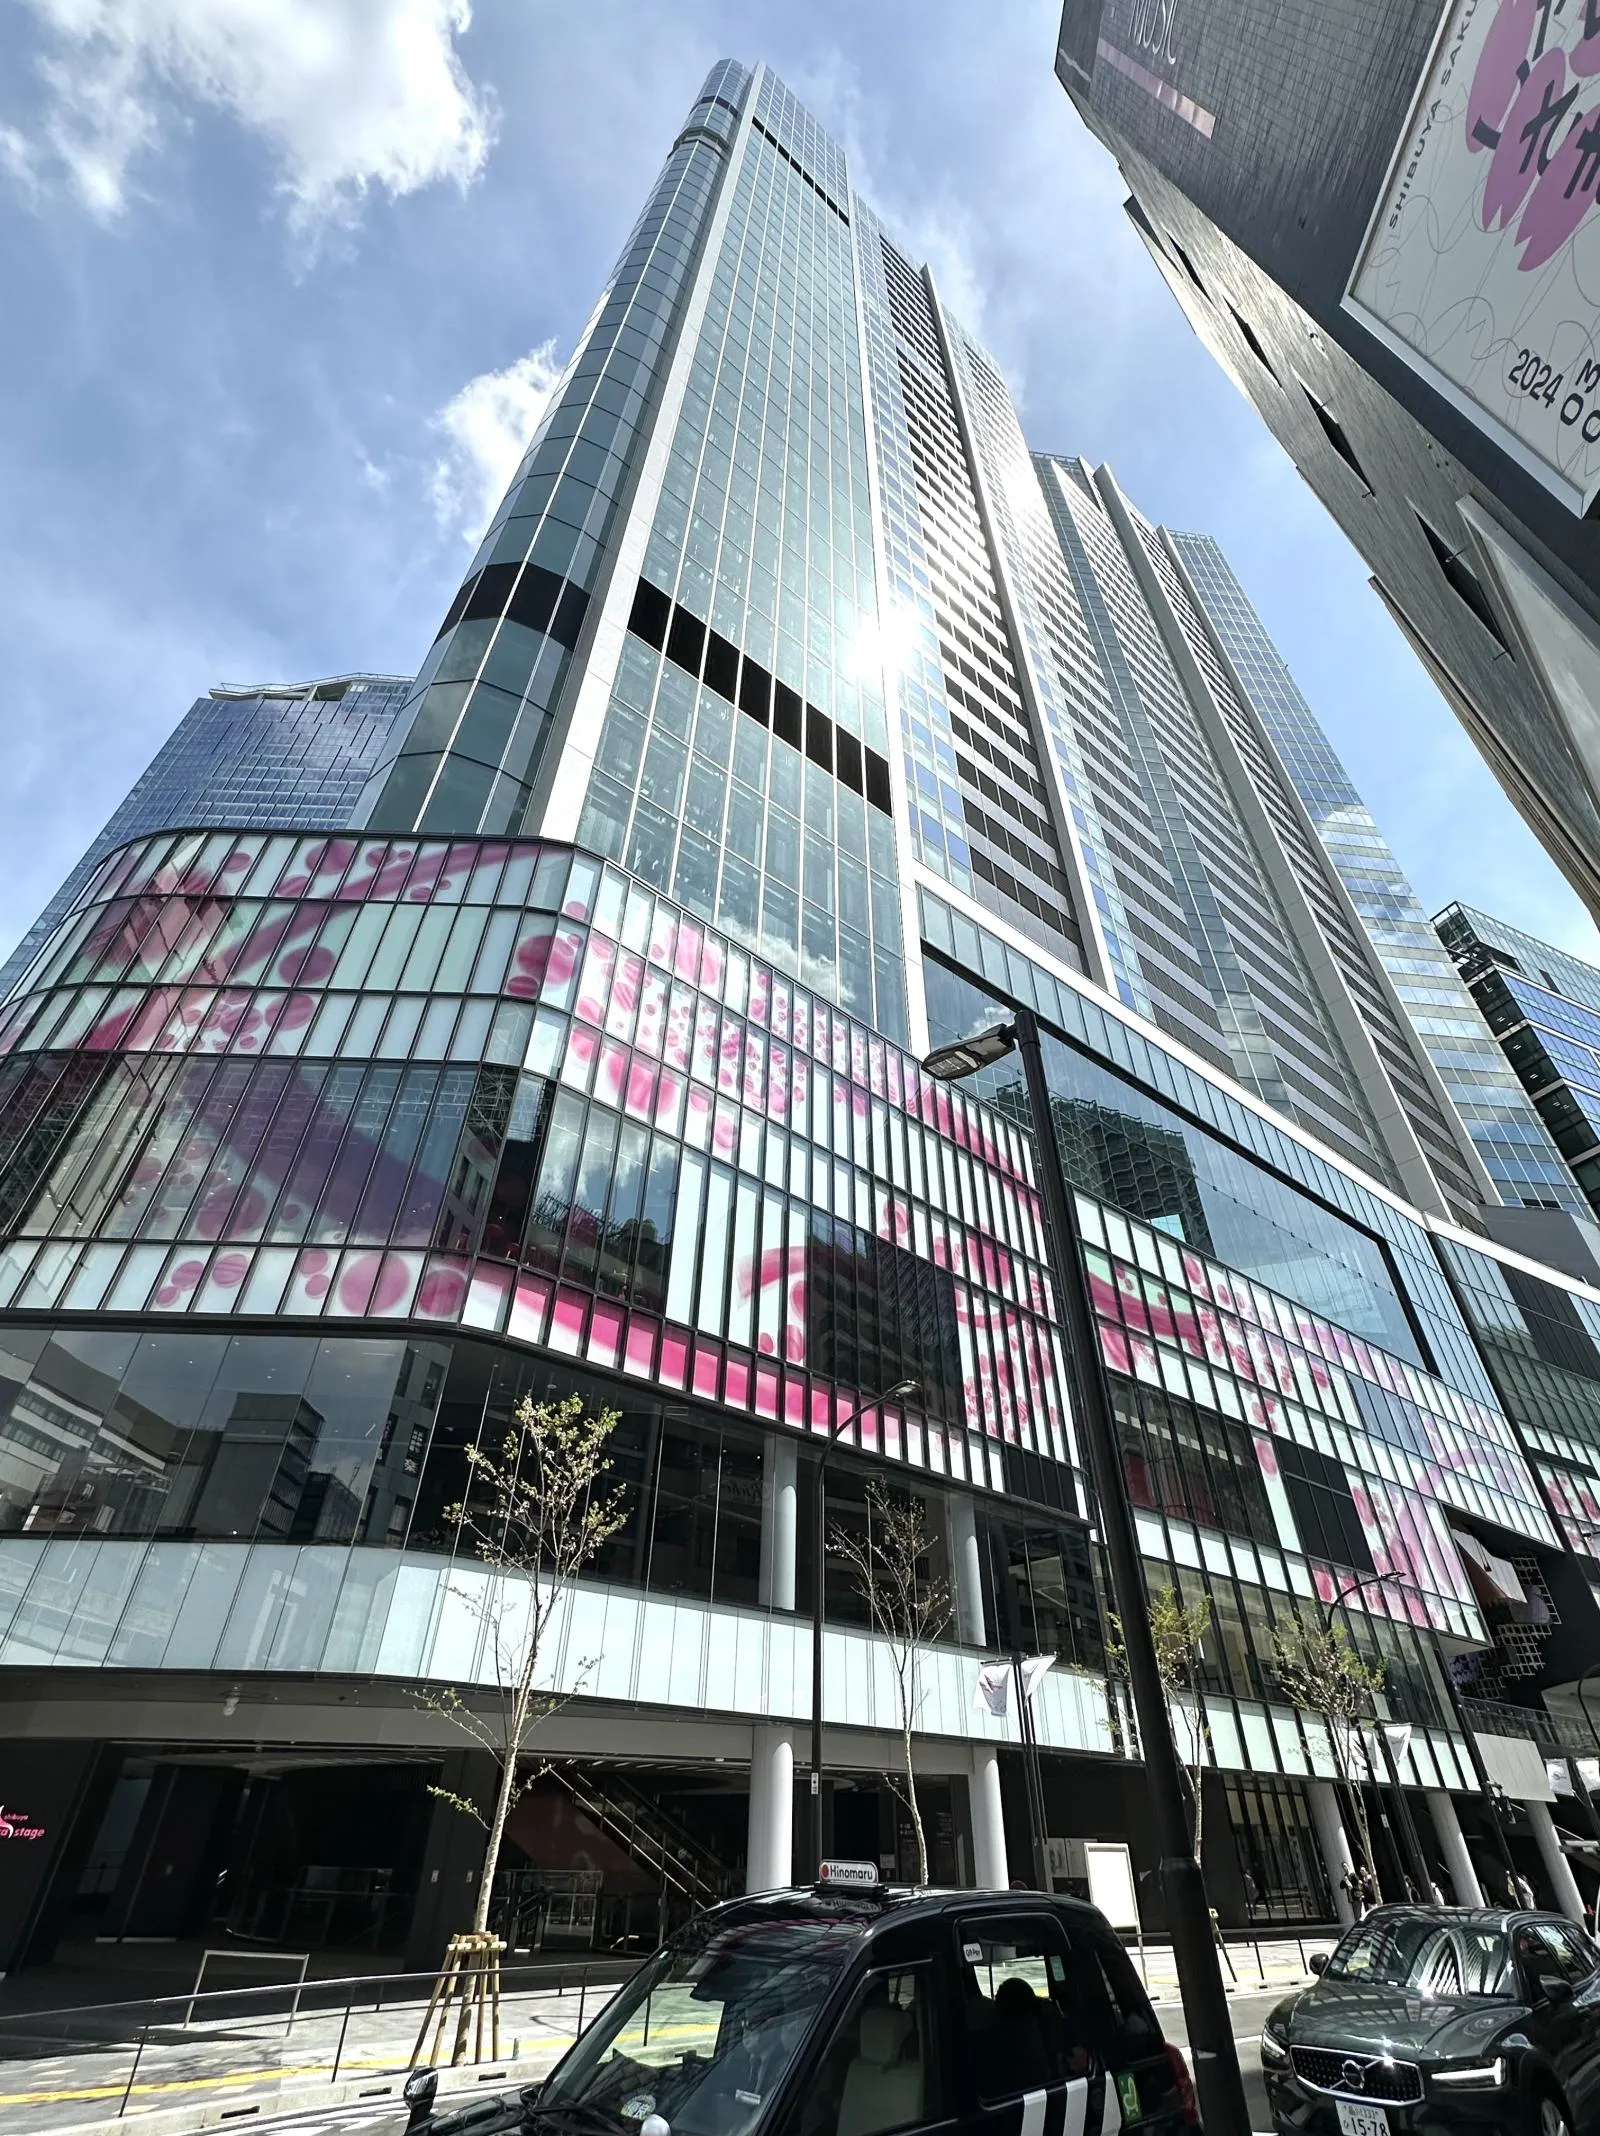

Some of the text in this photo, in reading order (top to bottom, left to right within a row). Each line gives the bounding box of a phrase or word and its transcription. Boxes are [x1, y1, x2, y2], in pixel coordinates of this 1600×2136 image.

[1389, 99, 1441, 229] SHIBUYA
[1508, 348, 1564, 408] 2024
[13, 1828, 45, 1839] stage
[830, 1864, 873, 1880] Hinomaru
